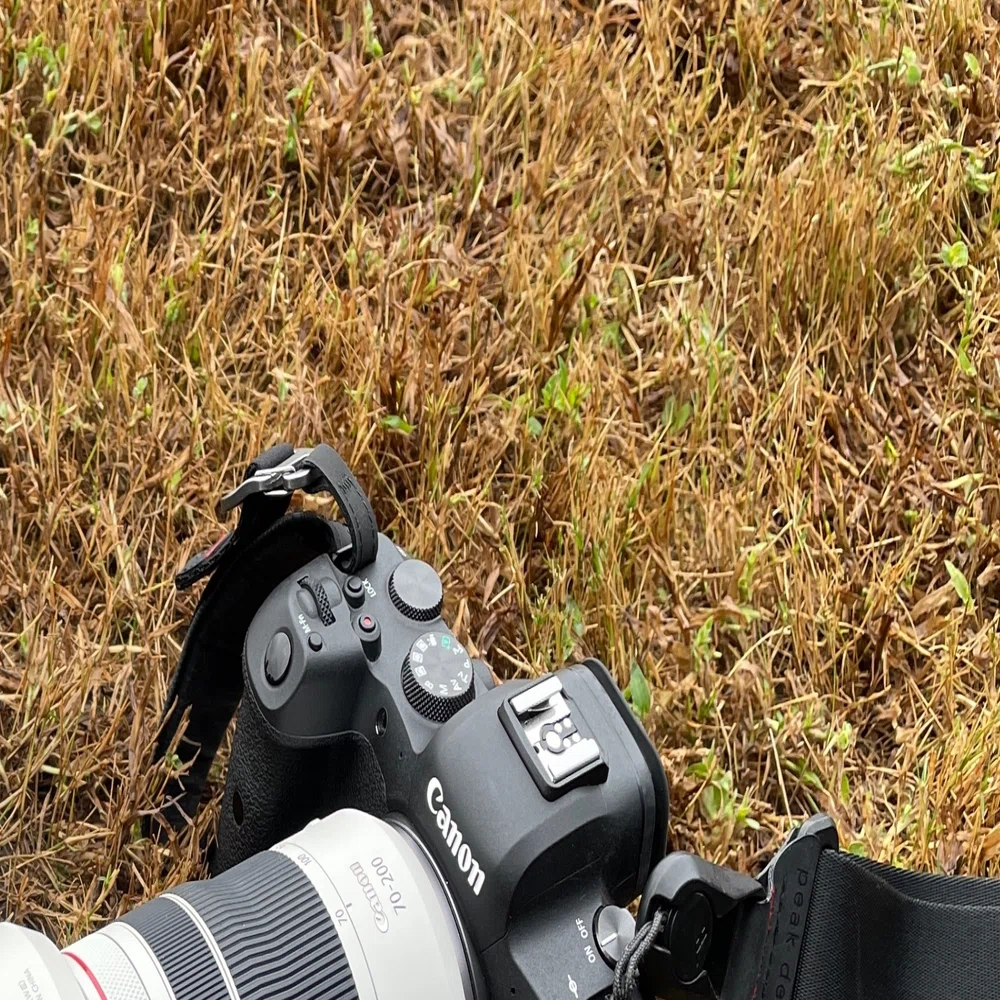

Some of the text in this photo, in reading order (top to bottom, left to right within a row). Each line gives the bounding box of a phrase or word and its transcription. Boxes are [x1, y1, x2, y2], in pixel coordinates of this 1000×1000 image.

[362, 578, 377, 598] LOCK
[426, 776, 486, 896] Canon
[349, 861, 390, 934] Canon
[371, 856, 407, 917] 70-200
[785, 867, 809, 947] peak
[335, 908, 348, 926] 70
[575, 917, 589, 939] OFF
[584, 945, 596, 964] ON
